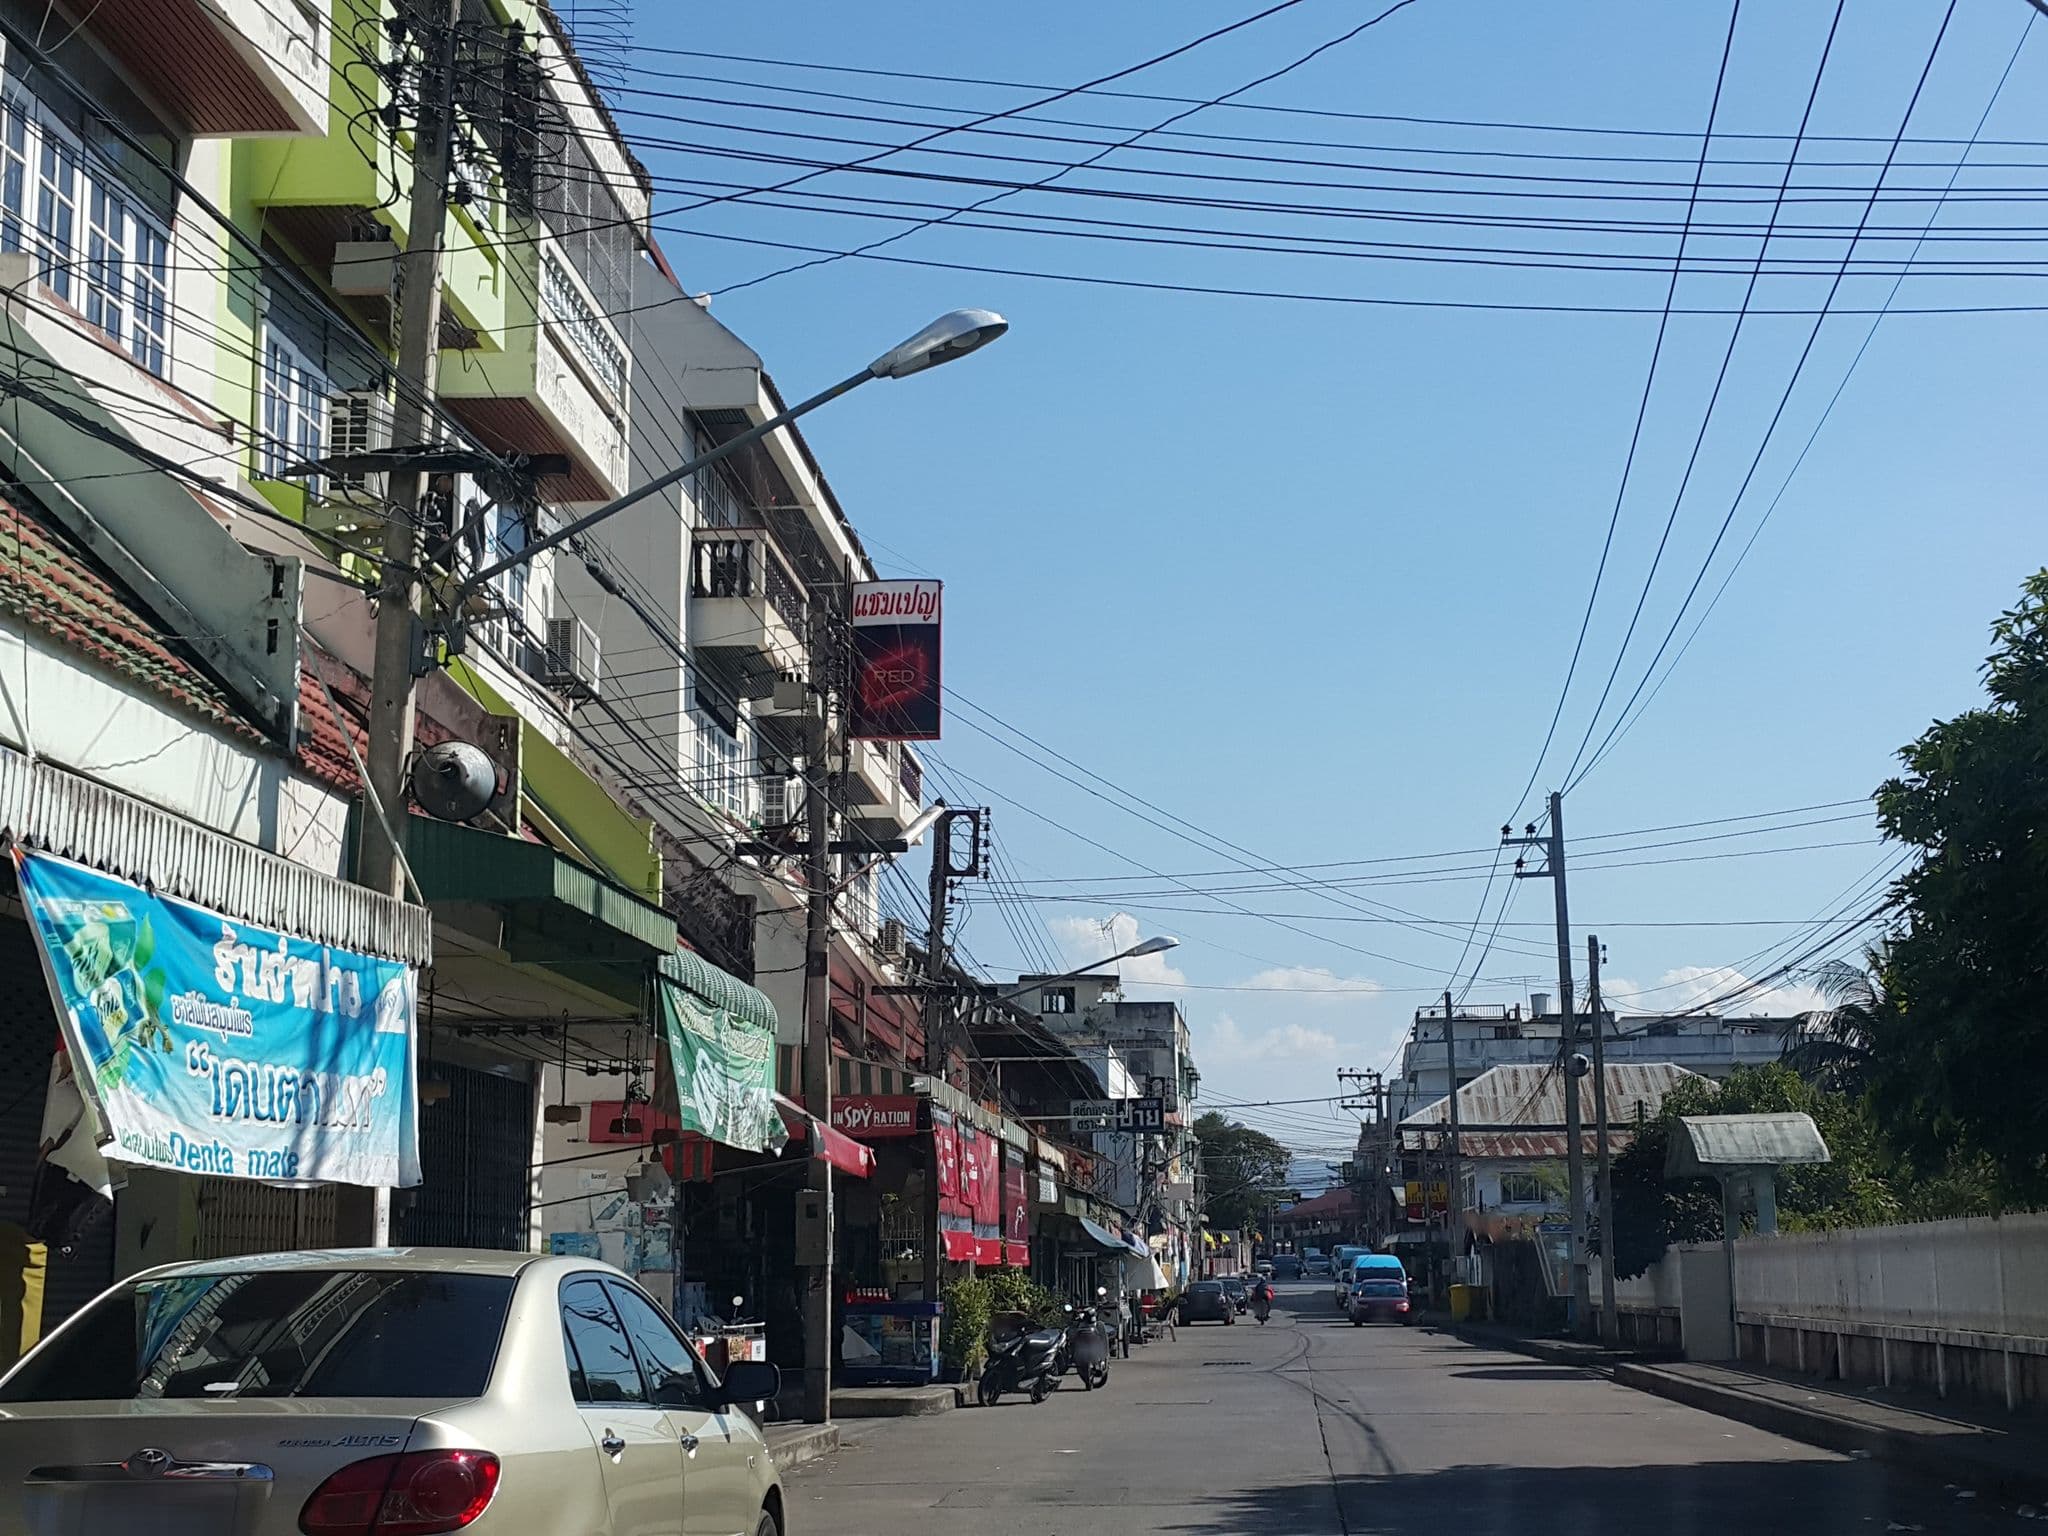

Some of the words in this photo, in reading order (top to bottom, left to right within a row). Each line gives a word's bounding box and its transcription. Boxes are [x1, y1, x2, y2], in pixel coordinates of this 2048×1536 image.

[855, 584, 936, 621] แชมเปญ
[874, 670, 914, 682] RED
[170, 1132, 234, 1173] Denta
[332, 1435, 400, 1447] ALTIS
